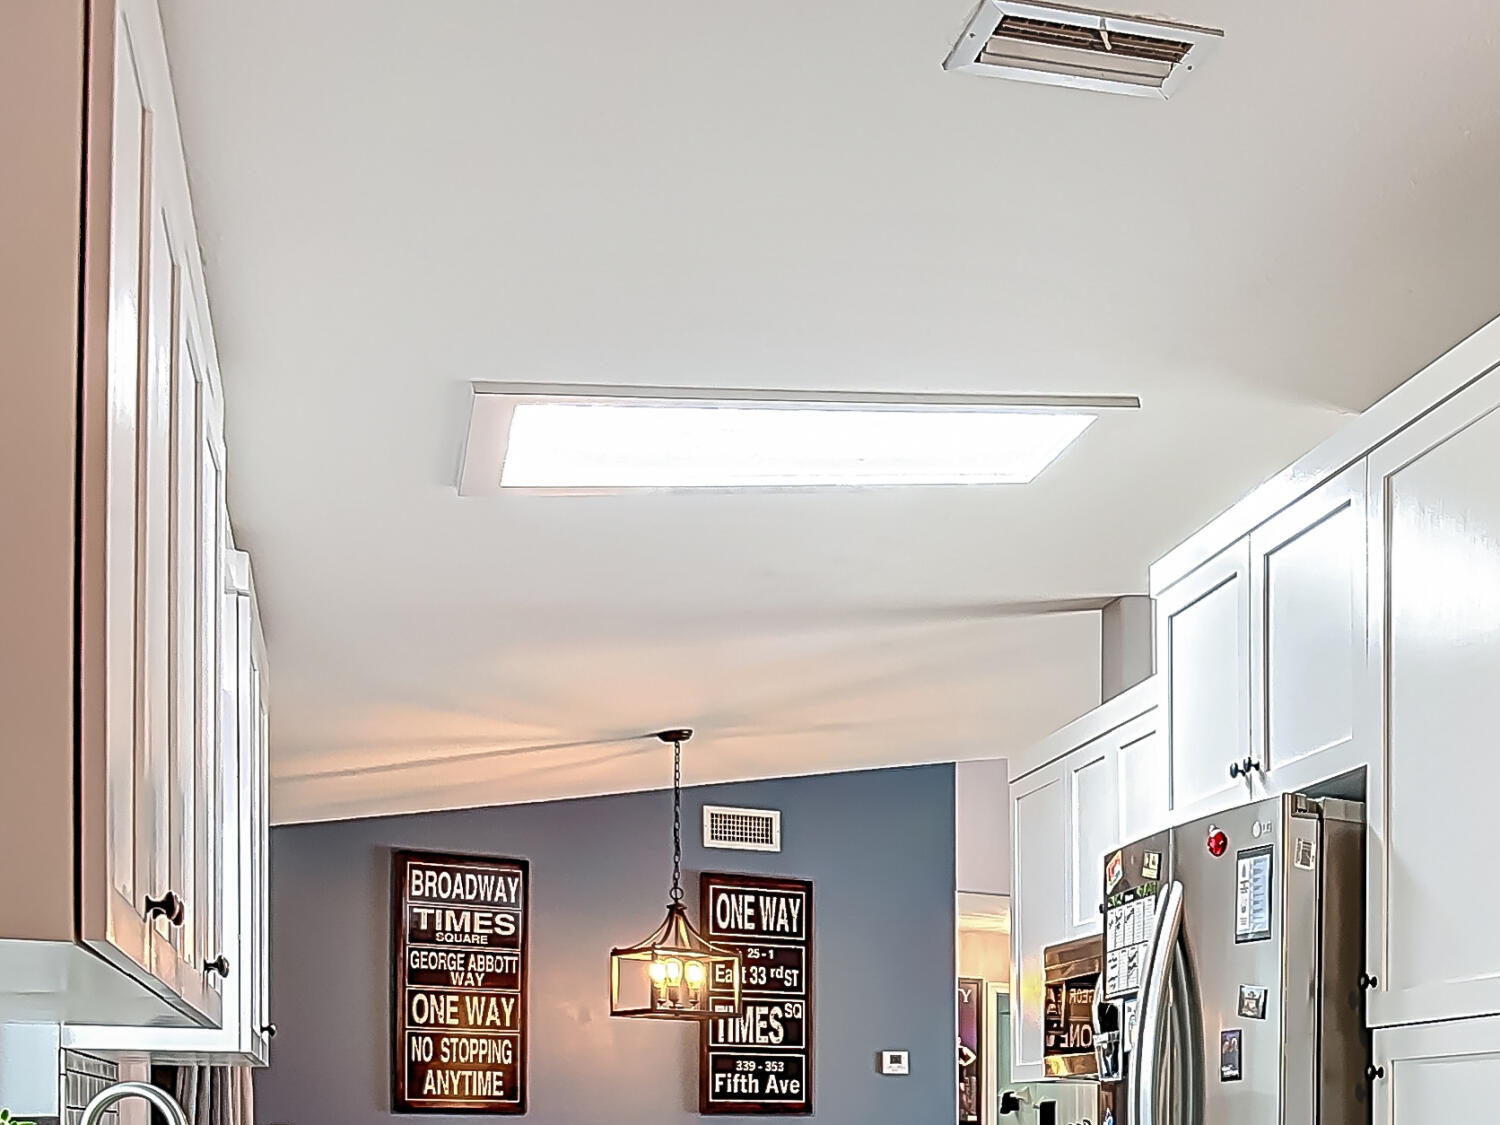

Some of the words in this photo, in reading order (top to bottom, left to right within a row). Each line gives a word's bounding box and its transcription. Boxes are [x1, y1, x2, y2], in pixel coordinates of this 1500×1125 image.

[411, 869, 519, 904] BROADWAY
[413, 908, 516, 936] TIMES
[716, 893, 756, 930] ONE
[759, 896, 801, 933] WAY
[435, 932, 489, 946] SQUARE
[410, 950, 465, 972] GEORGE
[467, 953, 519, 975] ABBOTT
[747, 948, 760, 959] 25
[450, 971, 486, 988] WAY
[715, 964, 747, 984] Eat
[750, 966, 767, 985] 33
[412, 993, 460, 1026] ONE
[464, 995, 516, 1028] WAY
[714, 1004, 785, 1045] TIMES
[784, 1002, 802, 1019] SQ
[411, 1036, 434, 1063] NO
[440, 1037, 513, 1065] STOPPING
[736, 1060, 756, 1072] 339
[764, 1060, 785, 1073] 353
[423, 1069, 505, 1097] ANYTIME
[714, 1073, 760, 1095] Fifth
[764, 1075, 801, 1095] Ave
